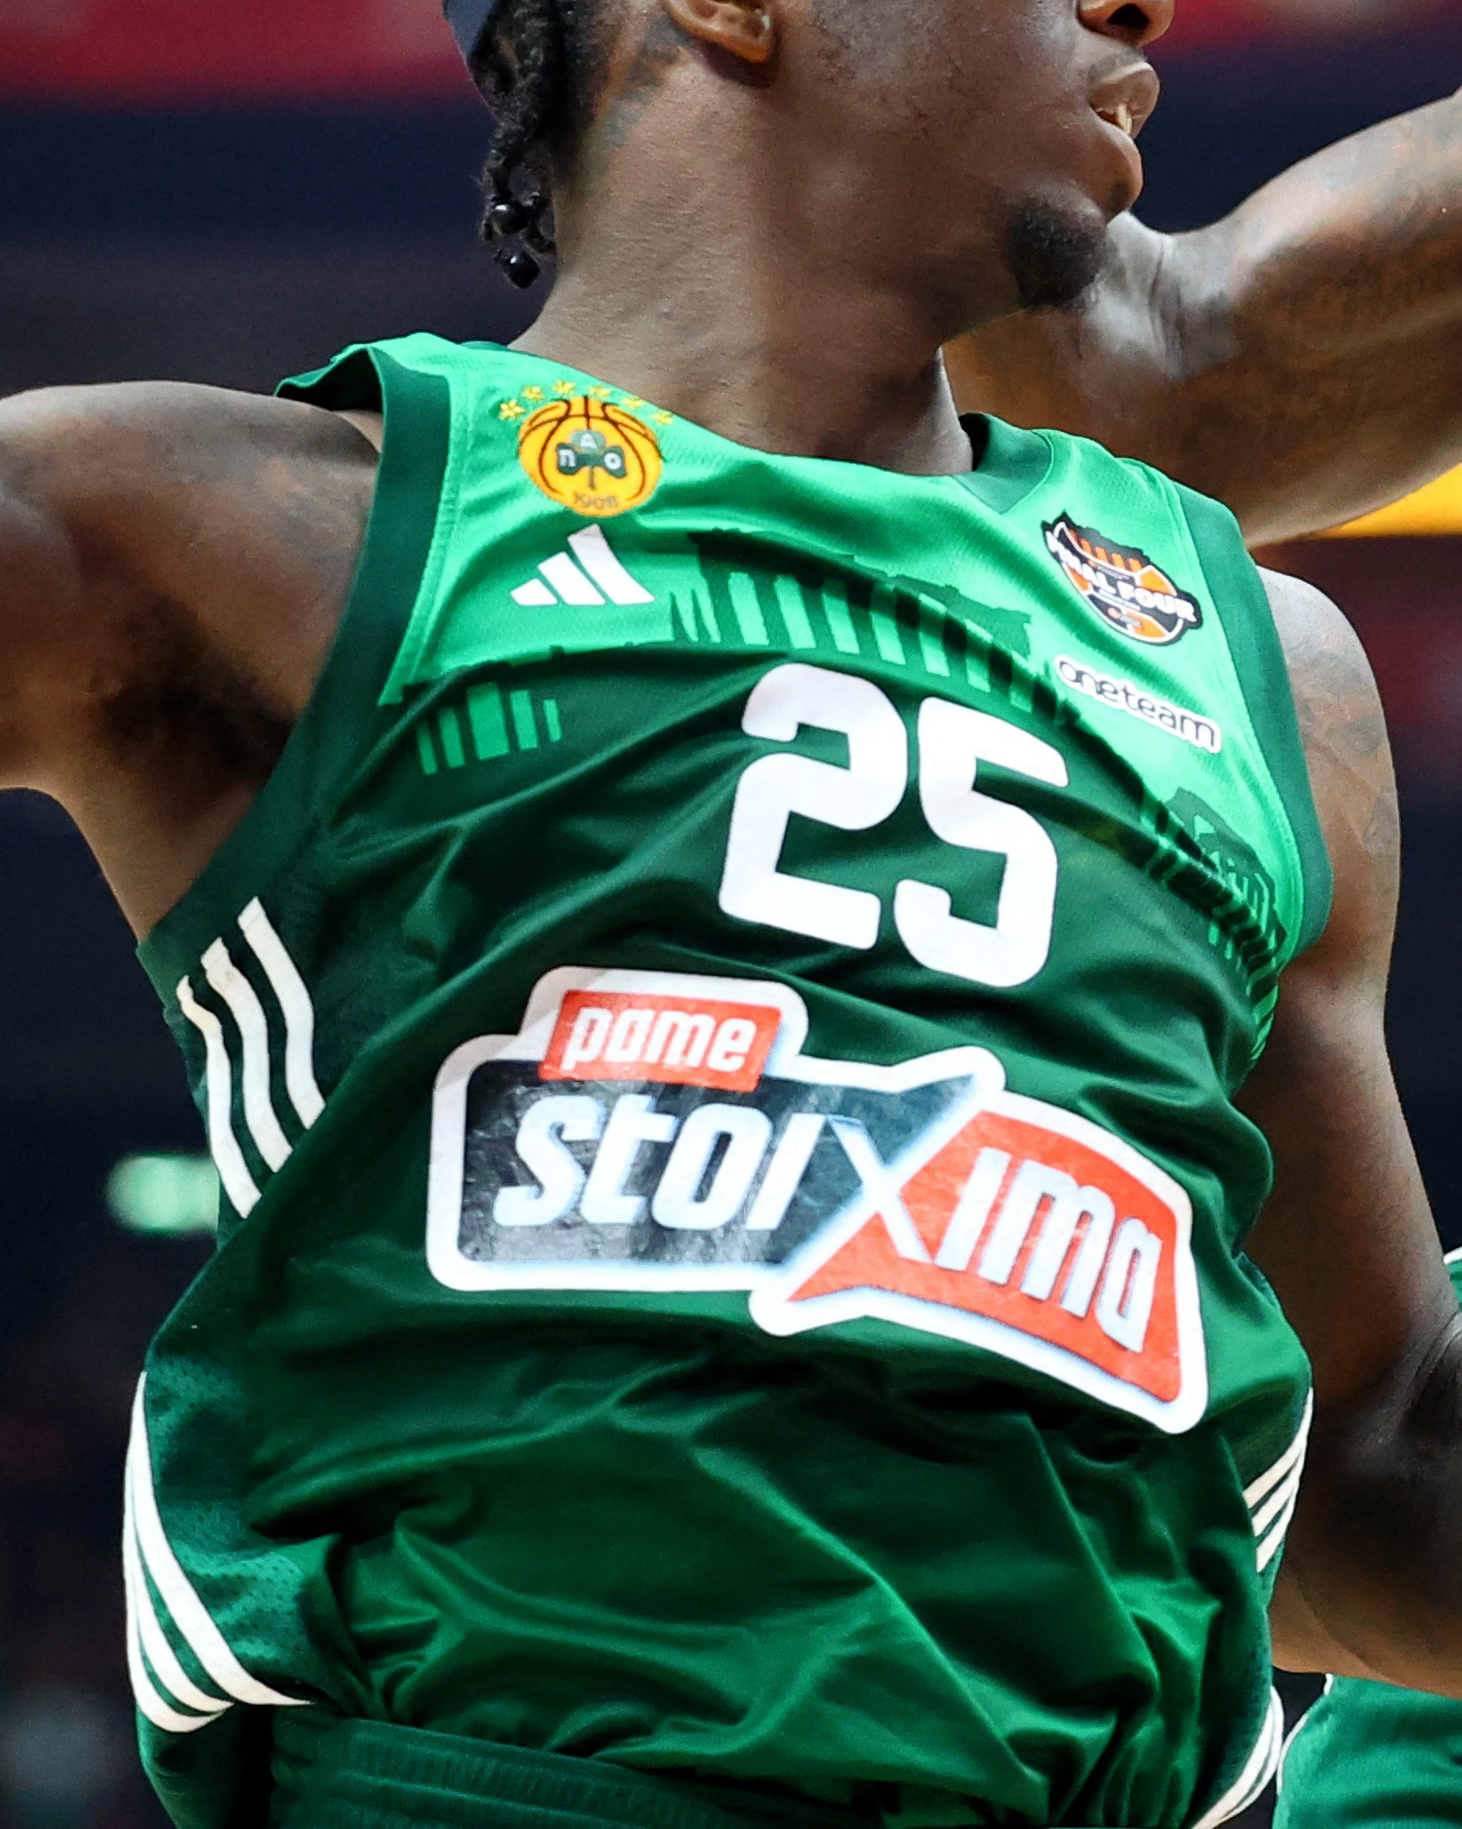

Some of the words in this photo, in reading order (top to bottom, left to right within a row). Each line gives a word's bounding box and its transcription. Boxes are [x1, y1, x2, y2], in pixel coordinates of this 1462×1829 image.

[1045, 530, 1117, 596] FINAL
[1118, 580, 1198, 622] FOUR
[1058, 660, 1216, 748] oneteam
[718, 663, 1070, 988] 25
[560, 1005, 756, 1074] pame
